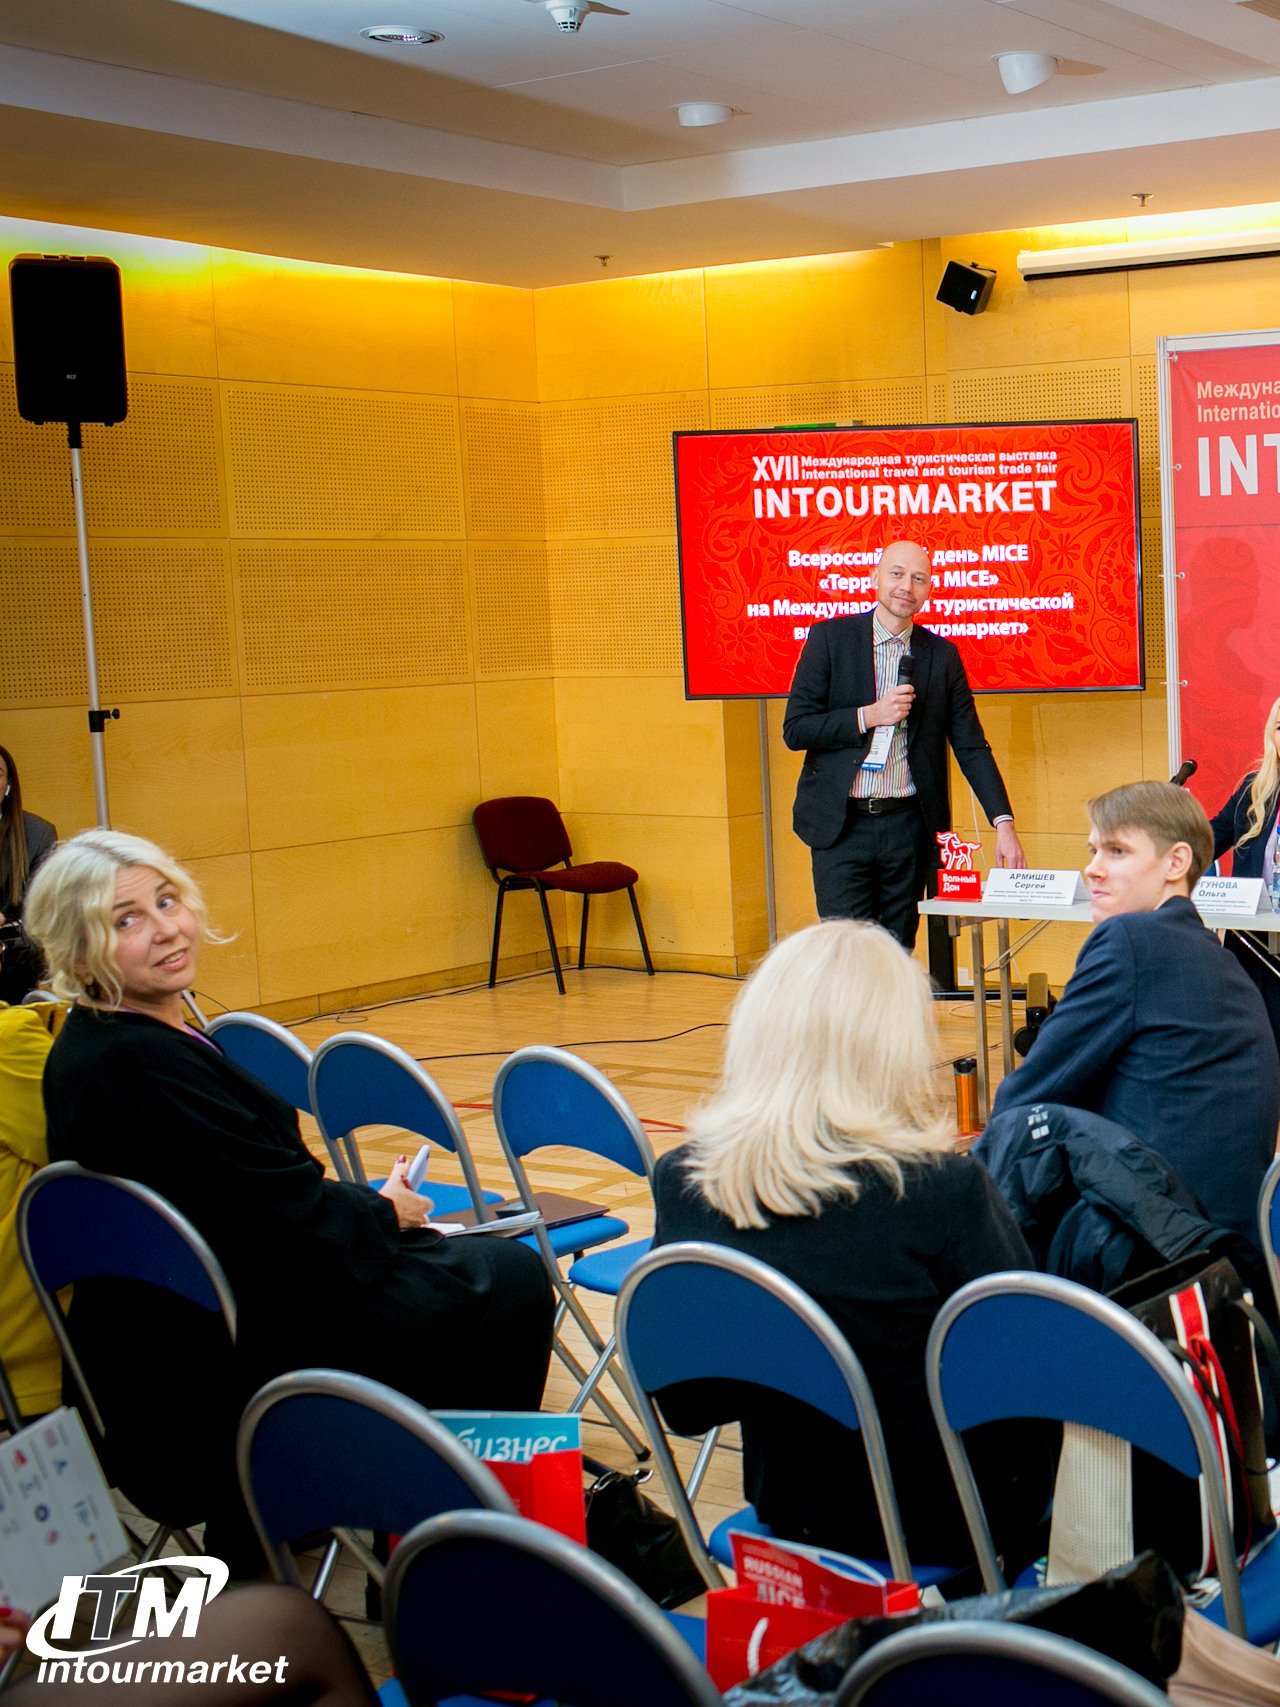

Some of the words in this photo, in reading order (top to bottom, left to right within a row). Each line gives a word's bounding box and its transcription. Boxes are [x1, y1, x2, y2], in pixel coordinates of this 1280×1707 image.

[801, 455, 902, 468] Международная
[904, 452, 996, 467] туристическая
[999, 450, 1058, 462] выставка
[752, 455, 799, 482] XVII
[801, 467, 880, 480] International
[883, 465, 919, 478] travel
[922, 464, 945, 477] and
[948, 463, 996, 476] tourism
[999, 462, 1033, 474] trade
[1036, 461, 1058, 473] fair
[754, 480, 1058, 519] INTOURMARKET
[932, 549, 980, 567] день
[982, 544, 1029, 562] MICE
[943, 569, 1000, 588] MICE»
[746, 603, 771, 617] на
[933, 592, 1074, 617] туристической
[942, 873, 977, 884] Вольный
[1009, 873, 1055, 881] АРМИШЕВ
[1014, 882, 1046, 890] Сергей
[1197, 881, 1238, 889] ГУНОВА
[942, 884, 960, 892] Дон
[1198, 890, 1227, 898] Ольга
